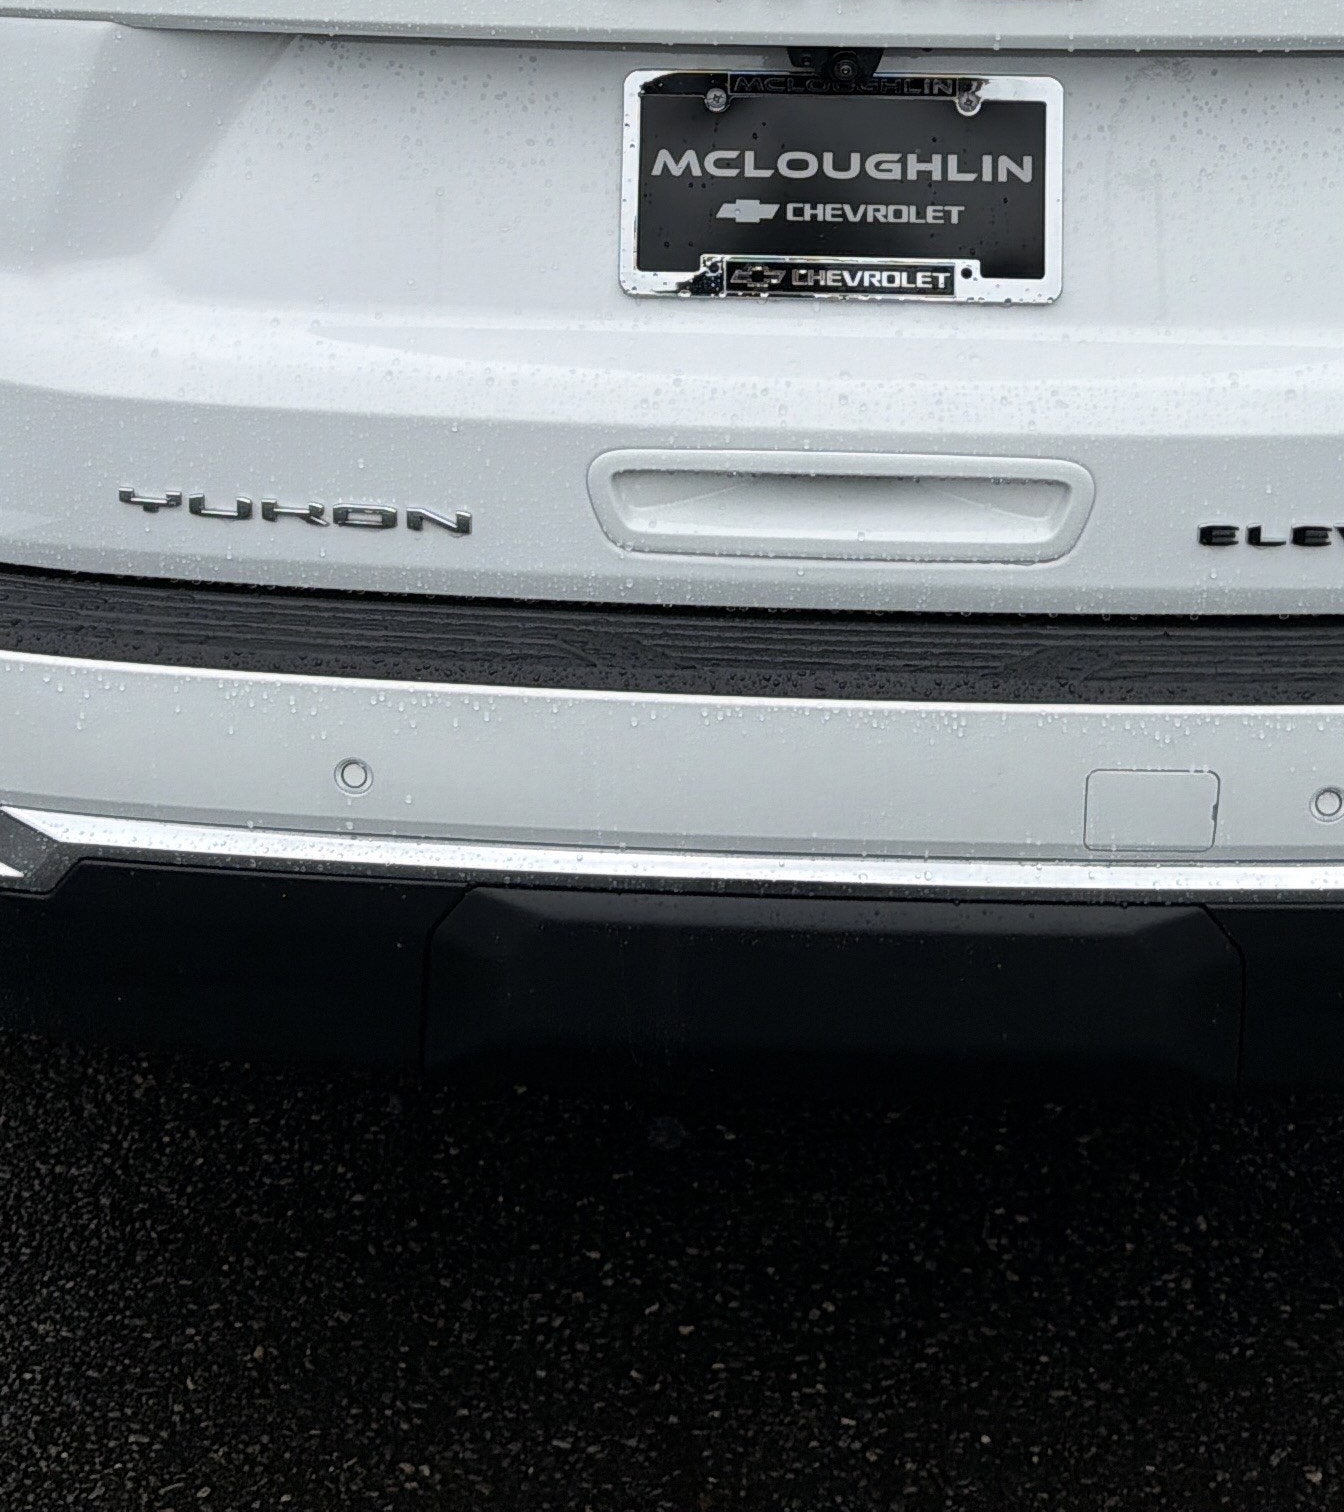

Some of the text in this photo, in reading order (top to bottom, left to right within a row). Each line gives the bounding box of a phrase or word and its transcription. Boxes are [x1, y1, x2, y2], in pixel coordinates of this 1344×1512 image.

[652, 149, 1032, 182] MCLOUGHLIN
[787, 204, 964, 224] CHEVROLET
[791, 269, 951, 289] CHEVROLET
[119, 487, 472, 535] YUKON
